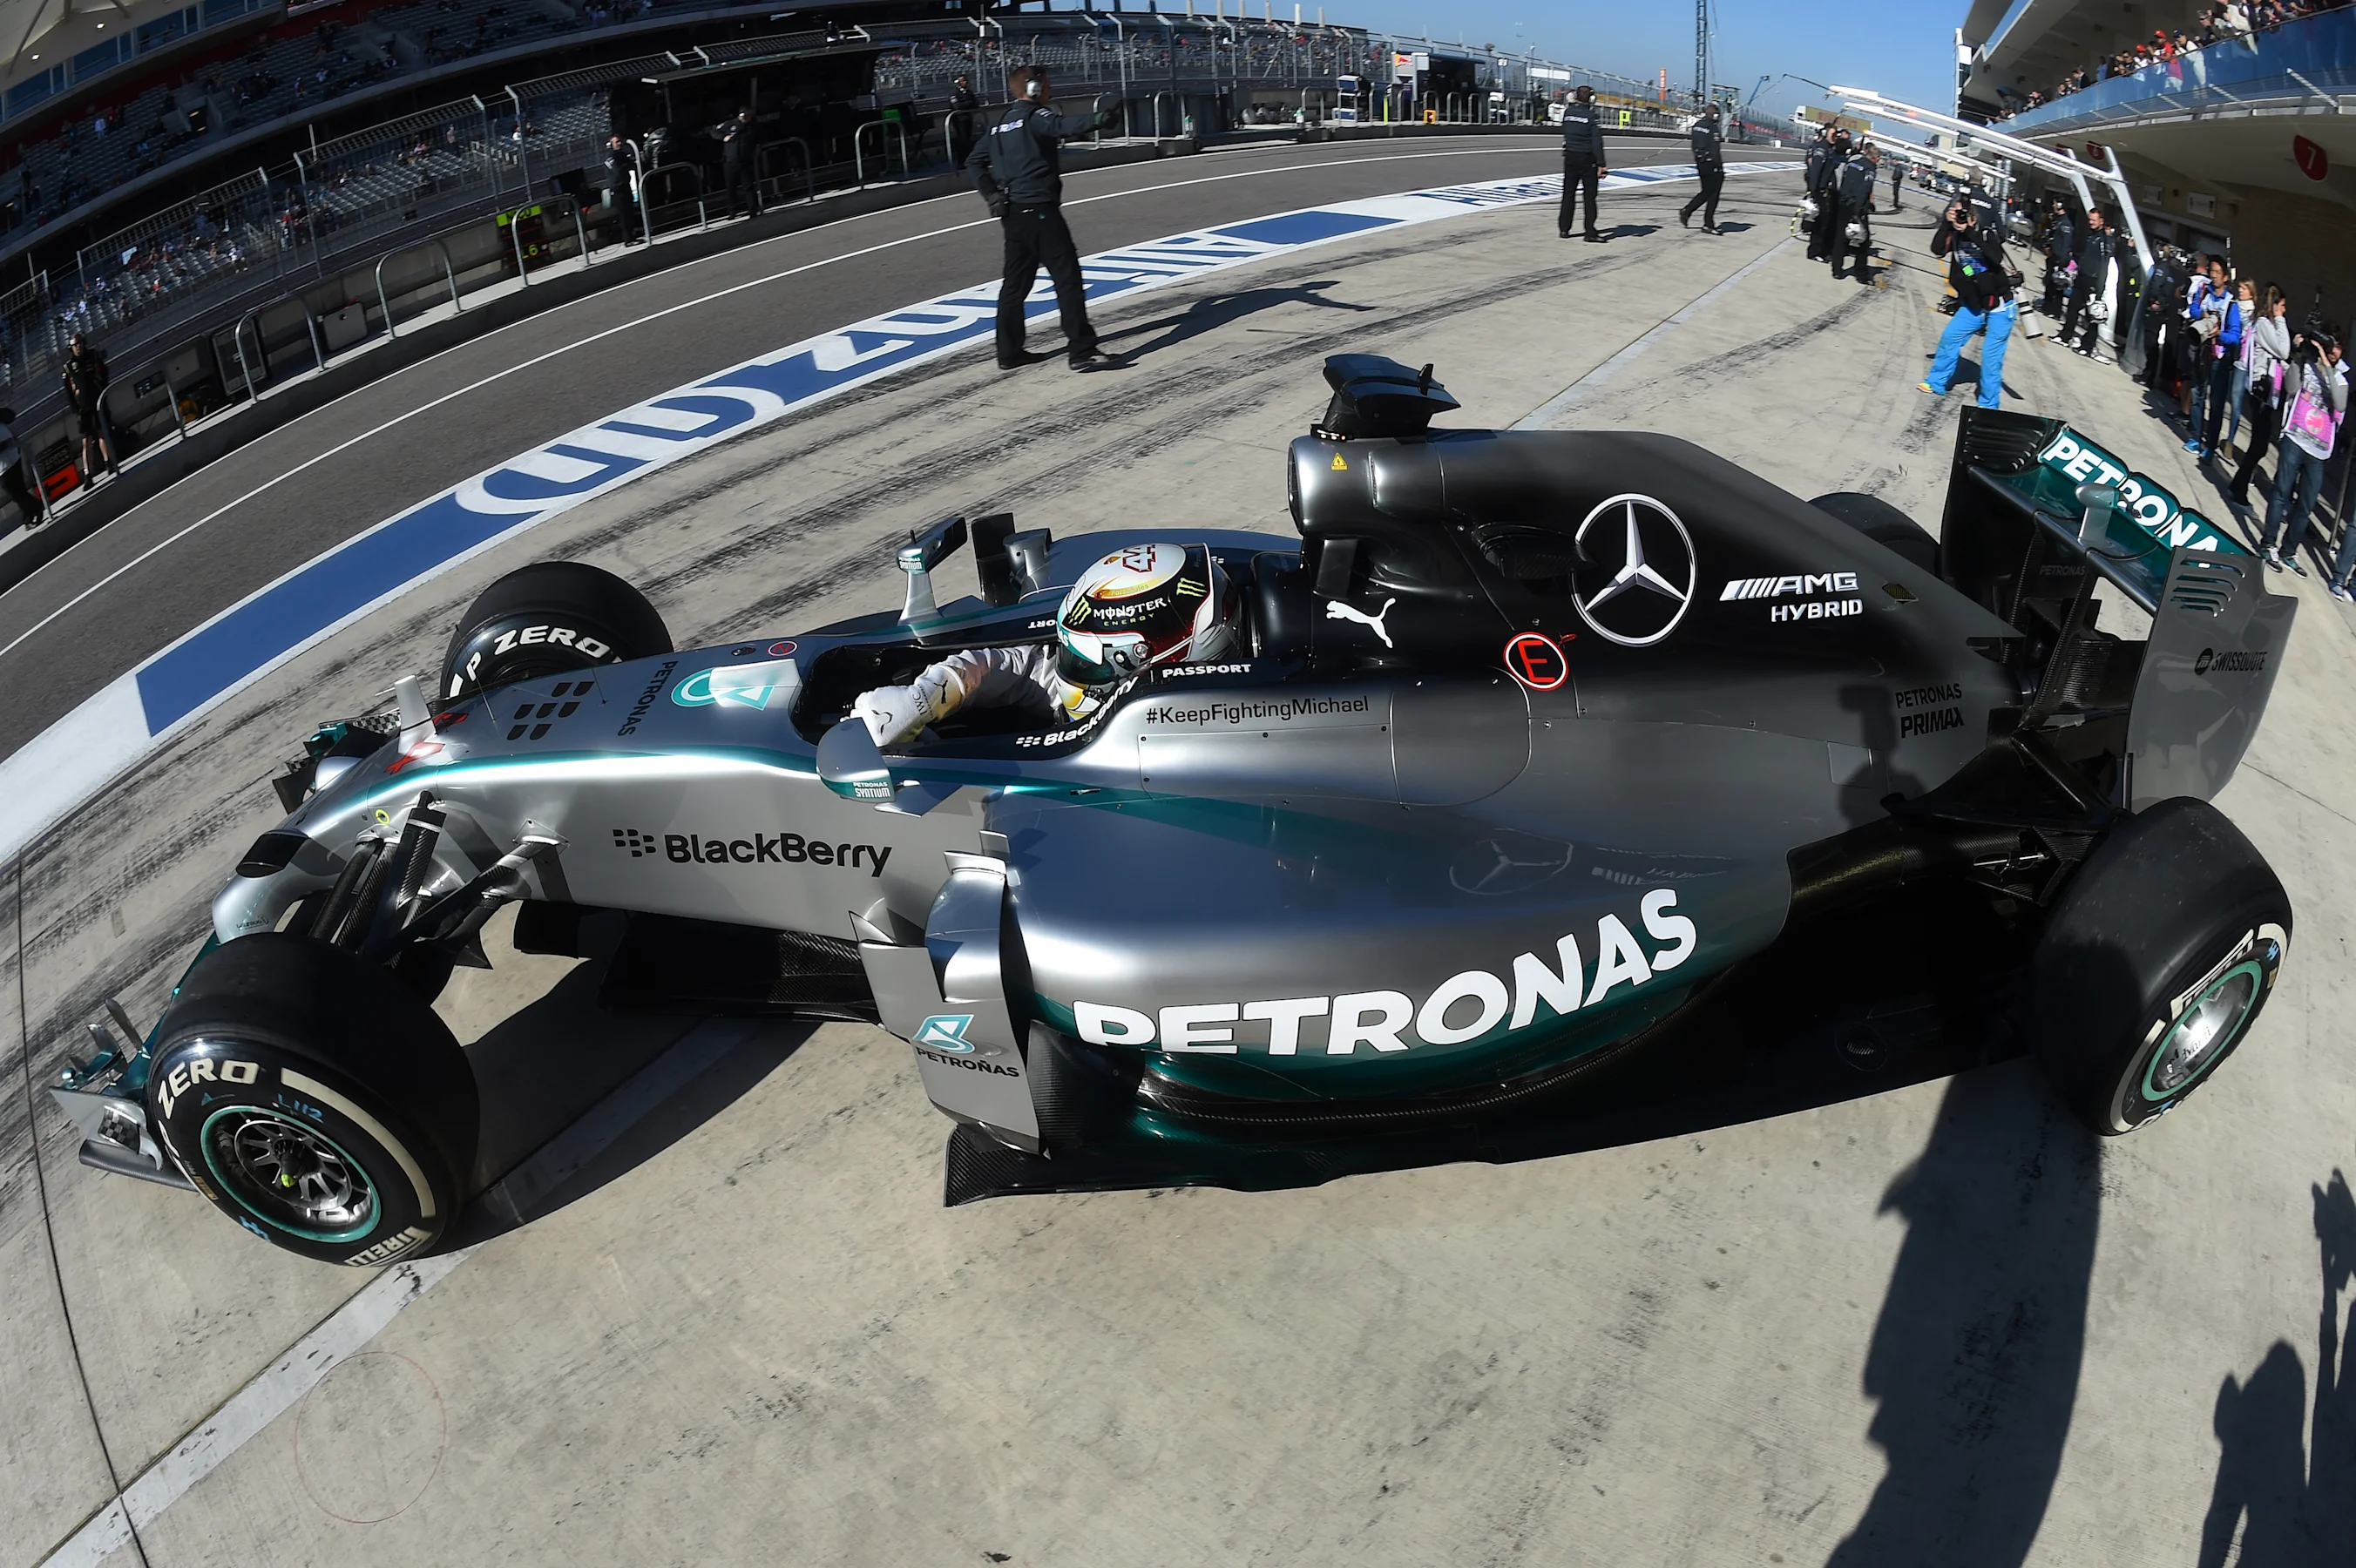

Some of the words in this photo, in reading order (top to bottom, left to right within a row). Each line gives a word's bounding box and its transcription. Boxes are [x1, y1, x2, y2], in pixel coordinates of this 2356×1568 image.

[2307, 145, 2317, 170] 7
[2044, 435, 2228, 555] PETRONA
[1770, 571, 1859, 598] AMG
[1093, 597, 1168, 622] MONSTER
[1103, 612, 1155, 627] ENERGY
[1770, 598, 1864, 623] HYBRID
[493, 625, 612, 659] ZERO
[1161, 663, 1252, 679] PASSPORT
[1517, 639, 1556, 684] E
[617, 659, 679, 738] PETRONAS
[1043, 675, 1140, 747] BlackBerry
[1146, 695, 1370, 727] #KeepFightingMichael
[1894, 682, 1963, 710] PETRONAS
[1900, 706, 1965, 740] PRIMAX
[855, 786, 891, 798] SYNTIUM
[664, 832, 893, 878] BlackBerry
[1072, 888, 1698, 1058] PETRONAS
[157, 1058, 261, 1120] ZERO
